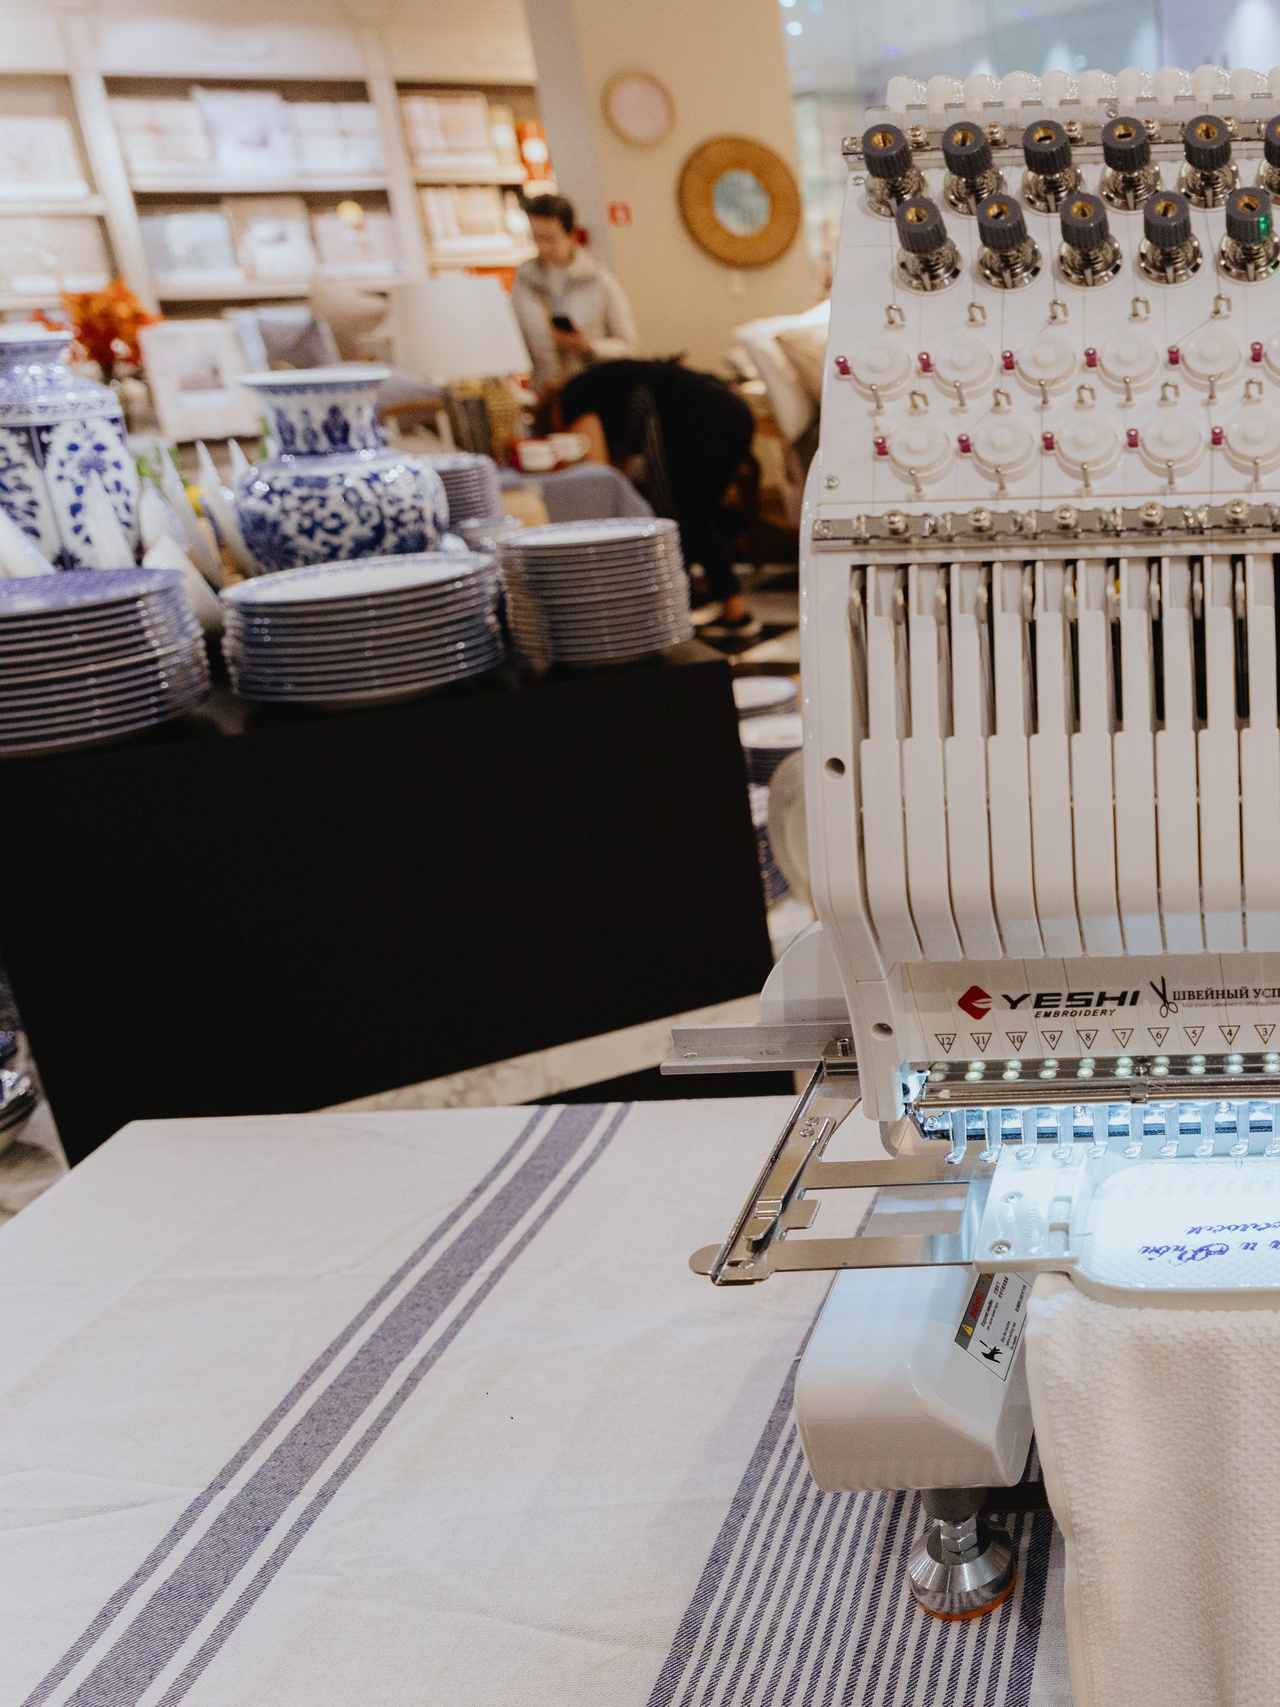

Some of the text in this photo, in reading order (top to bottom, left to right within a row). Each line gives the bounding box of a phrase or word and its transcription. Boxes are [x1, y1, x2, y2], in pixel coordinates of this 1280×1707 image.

[1001, 990, 1140, 1010] YESHI
[1172, 986, 1249, 1000] ШВЕЙНЫЙ
[1034, 1009, 1116, 1019] EMBROIDERY
[1239, 1241, 1258, 1252] и
[970, 1291, 985, 1319] WARNING
